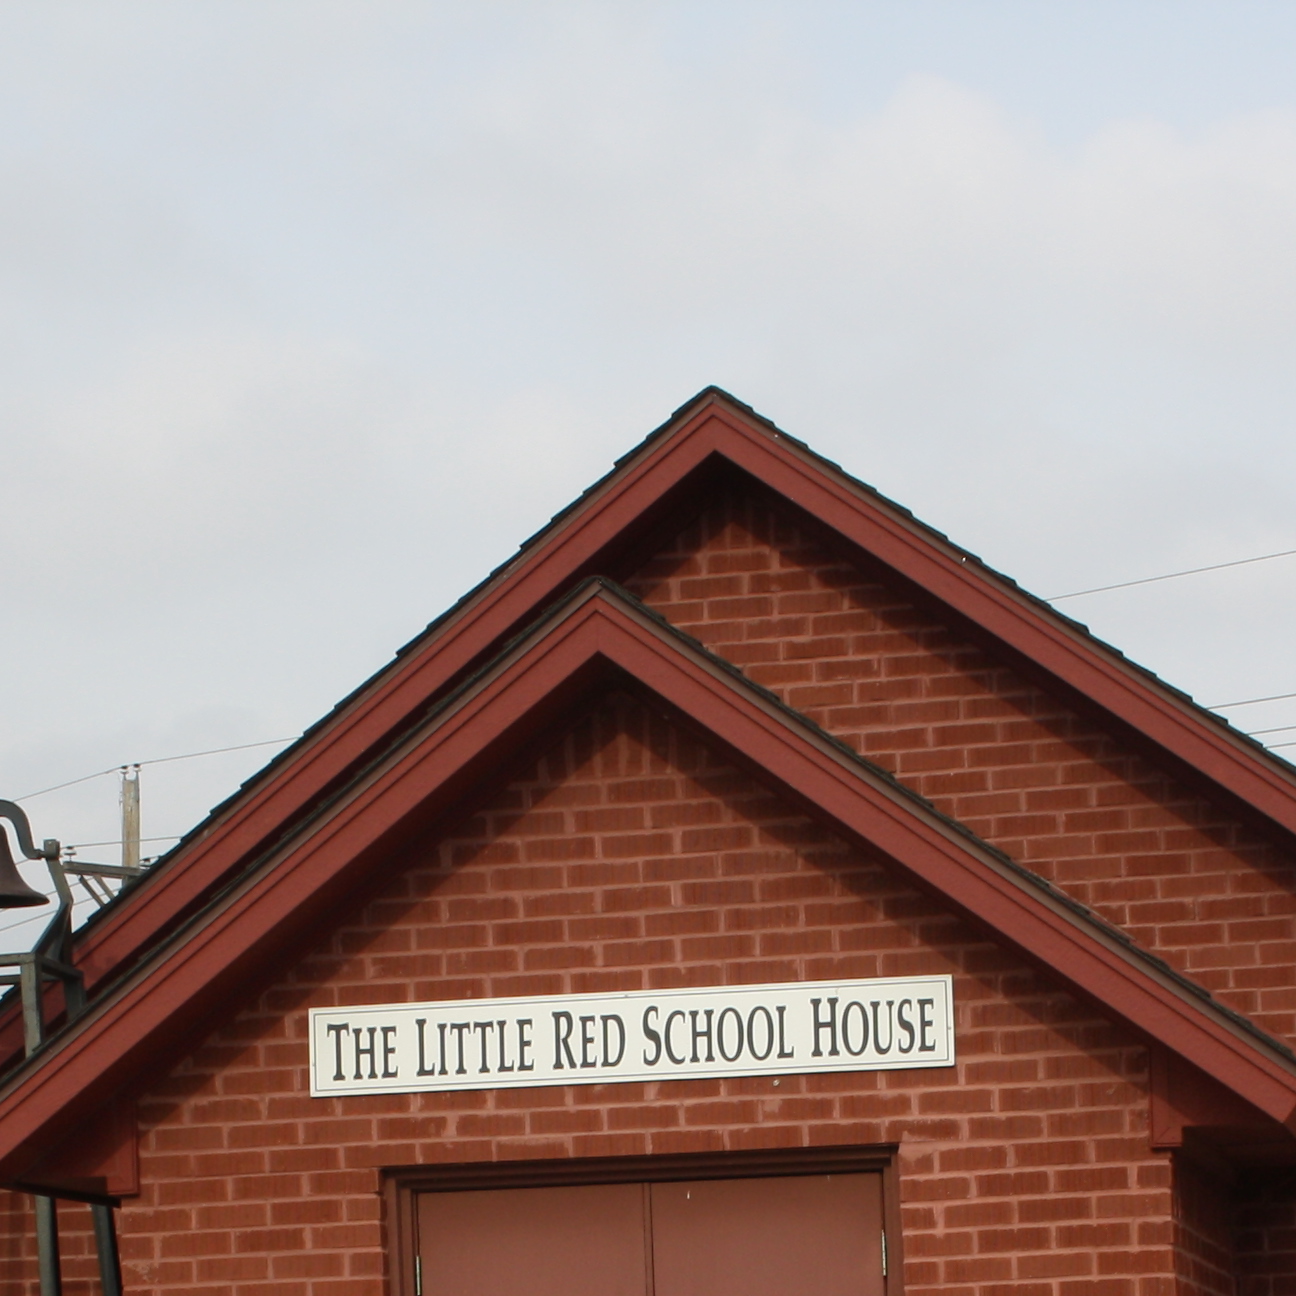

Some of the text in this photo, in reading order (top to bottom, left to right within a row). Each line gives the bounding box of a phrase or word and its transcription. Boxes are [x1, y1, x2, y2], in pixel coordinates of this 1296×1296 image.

[327, 997, 937, 1081] THE LITTLE RED SCHOOL HOUSE
